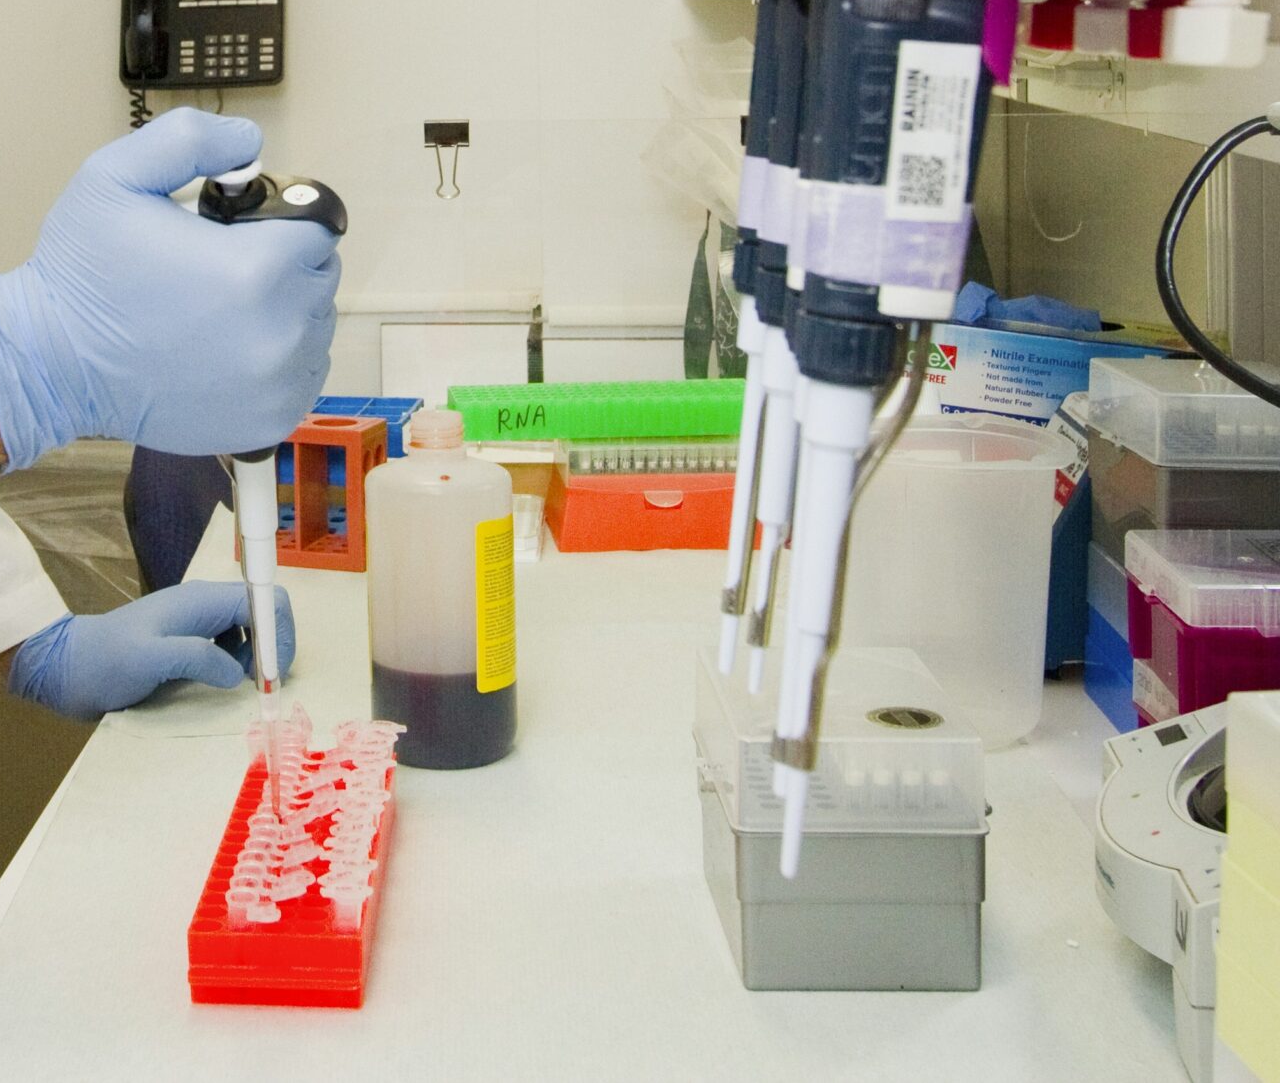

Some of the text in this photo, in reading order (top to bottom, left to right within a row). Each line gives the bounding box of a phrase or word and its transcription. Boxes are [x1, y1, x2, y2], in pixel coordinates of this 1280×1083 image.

[991, 348, 1025, 362] Nitrile
[987, 361, 1052, 377] Textured Fingers
[986, 372, 1043, 387] Not made from
[985, 383, 1013, 394] Natural
[1015, 387, 1043, 397] Rubber
[984, 394, 1033, 408] Powder Free
[497, 404, 547, 434] RNA
